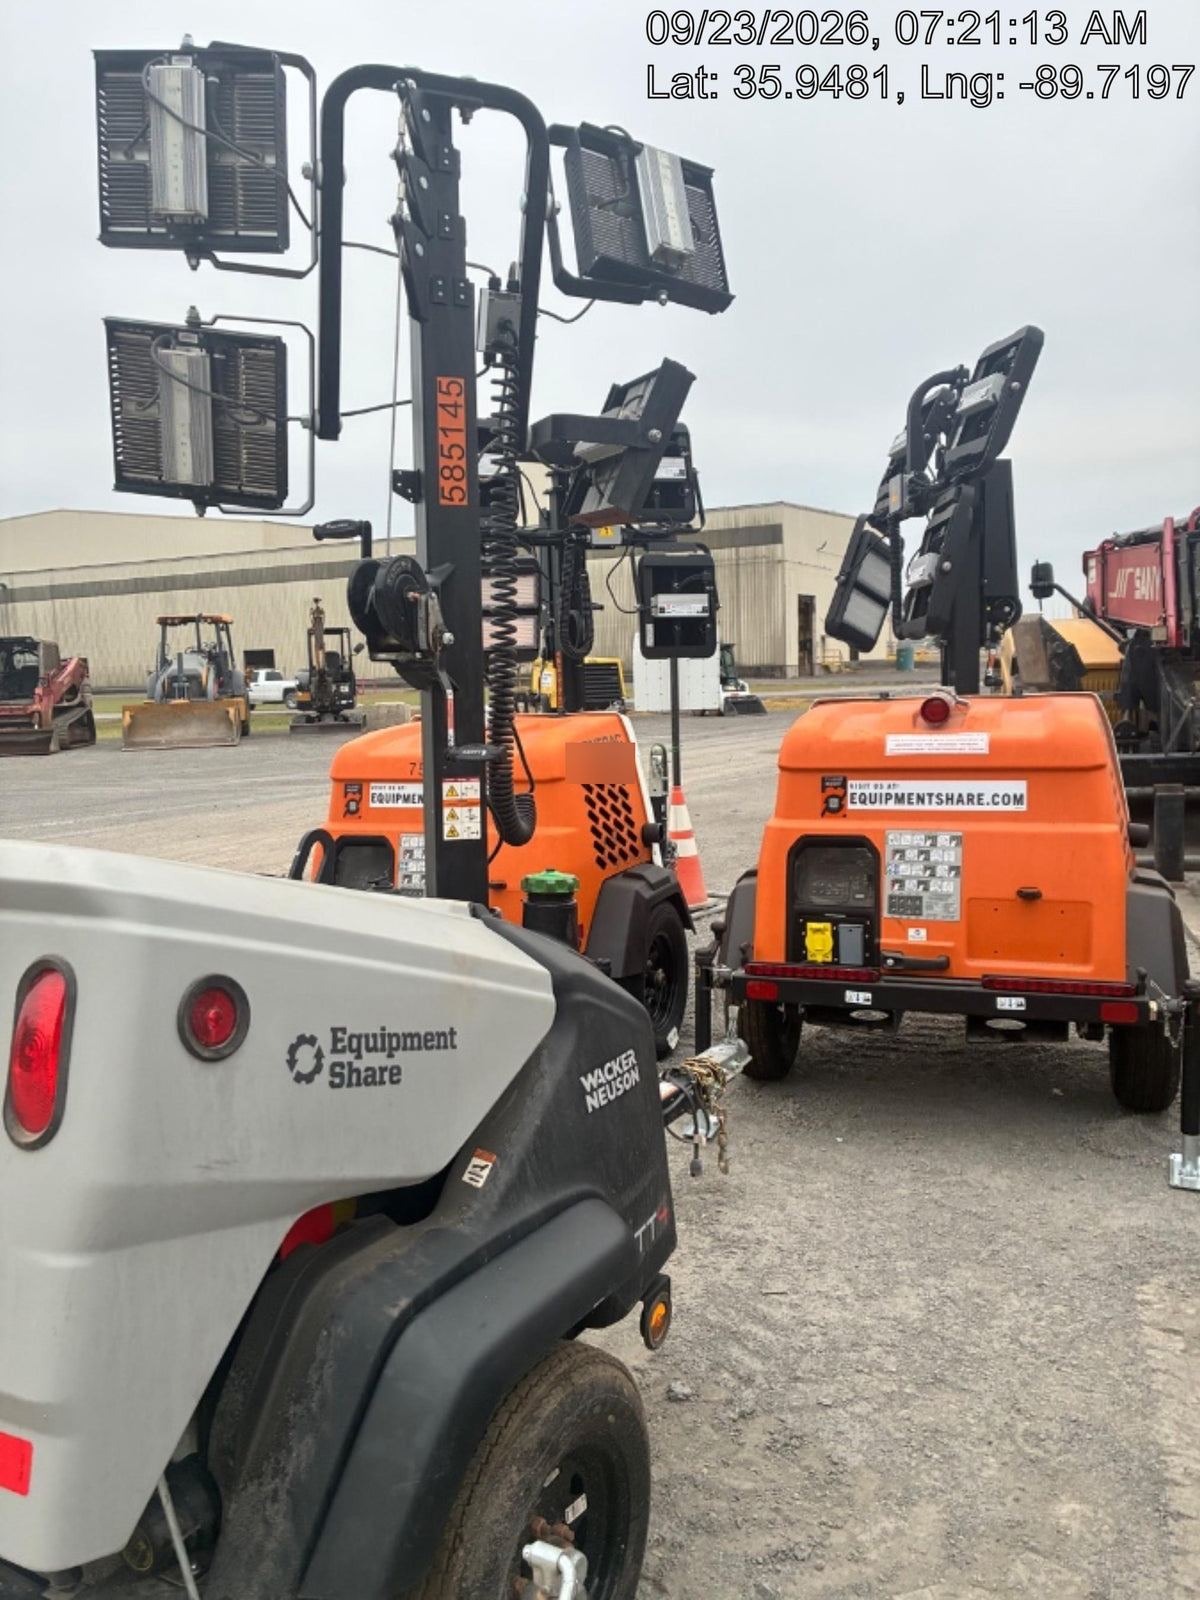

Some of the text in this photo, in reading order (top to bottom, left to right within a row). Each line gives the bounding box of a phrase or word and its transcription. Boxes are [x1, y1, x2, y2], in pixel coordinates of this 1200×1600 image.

[439, 380, 466, 502] 585145
[849, 792, 1025, 806] EQUIPMENTSHARE.COM
[330, 1026, 457, 1060] Equipment
[328, 1061, 402, 1089] Share
[579, 1048, 637, 1092] WACKER
[585, 1065, 640, 1114] NEUSON
